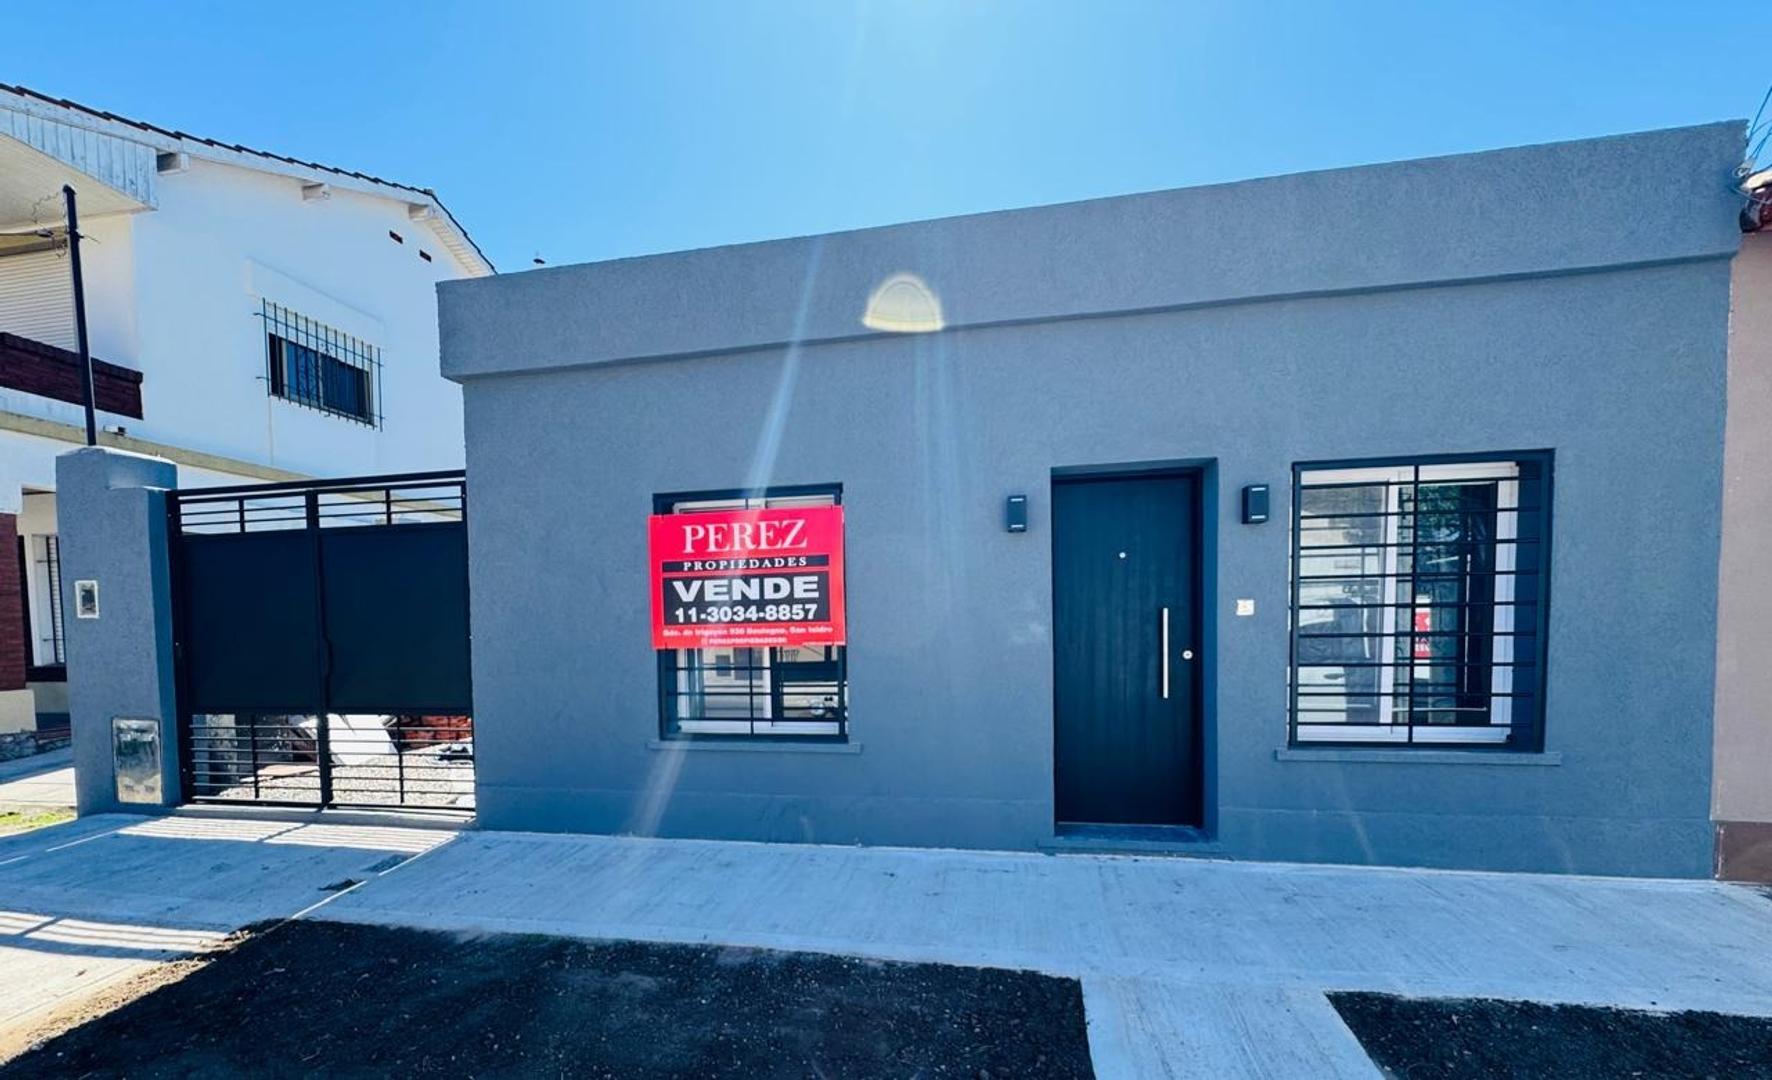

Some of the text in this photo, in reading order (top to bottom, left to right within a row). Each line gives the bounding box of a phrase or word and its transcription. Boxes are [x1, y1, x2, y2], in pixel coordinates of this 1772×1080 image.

[682, 519, 808, 554] PEREZ
[683, 556, 808, 571] PROPIEDADES
[672, 575, 820, 602] VENDE
[675, 604, 818, 623] 11-3034-8857
